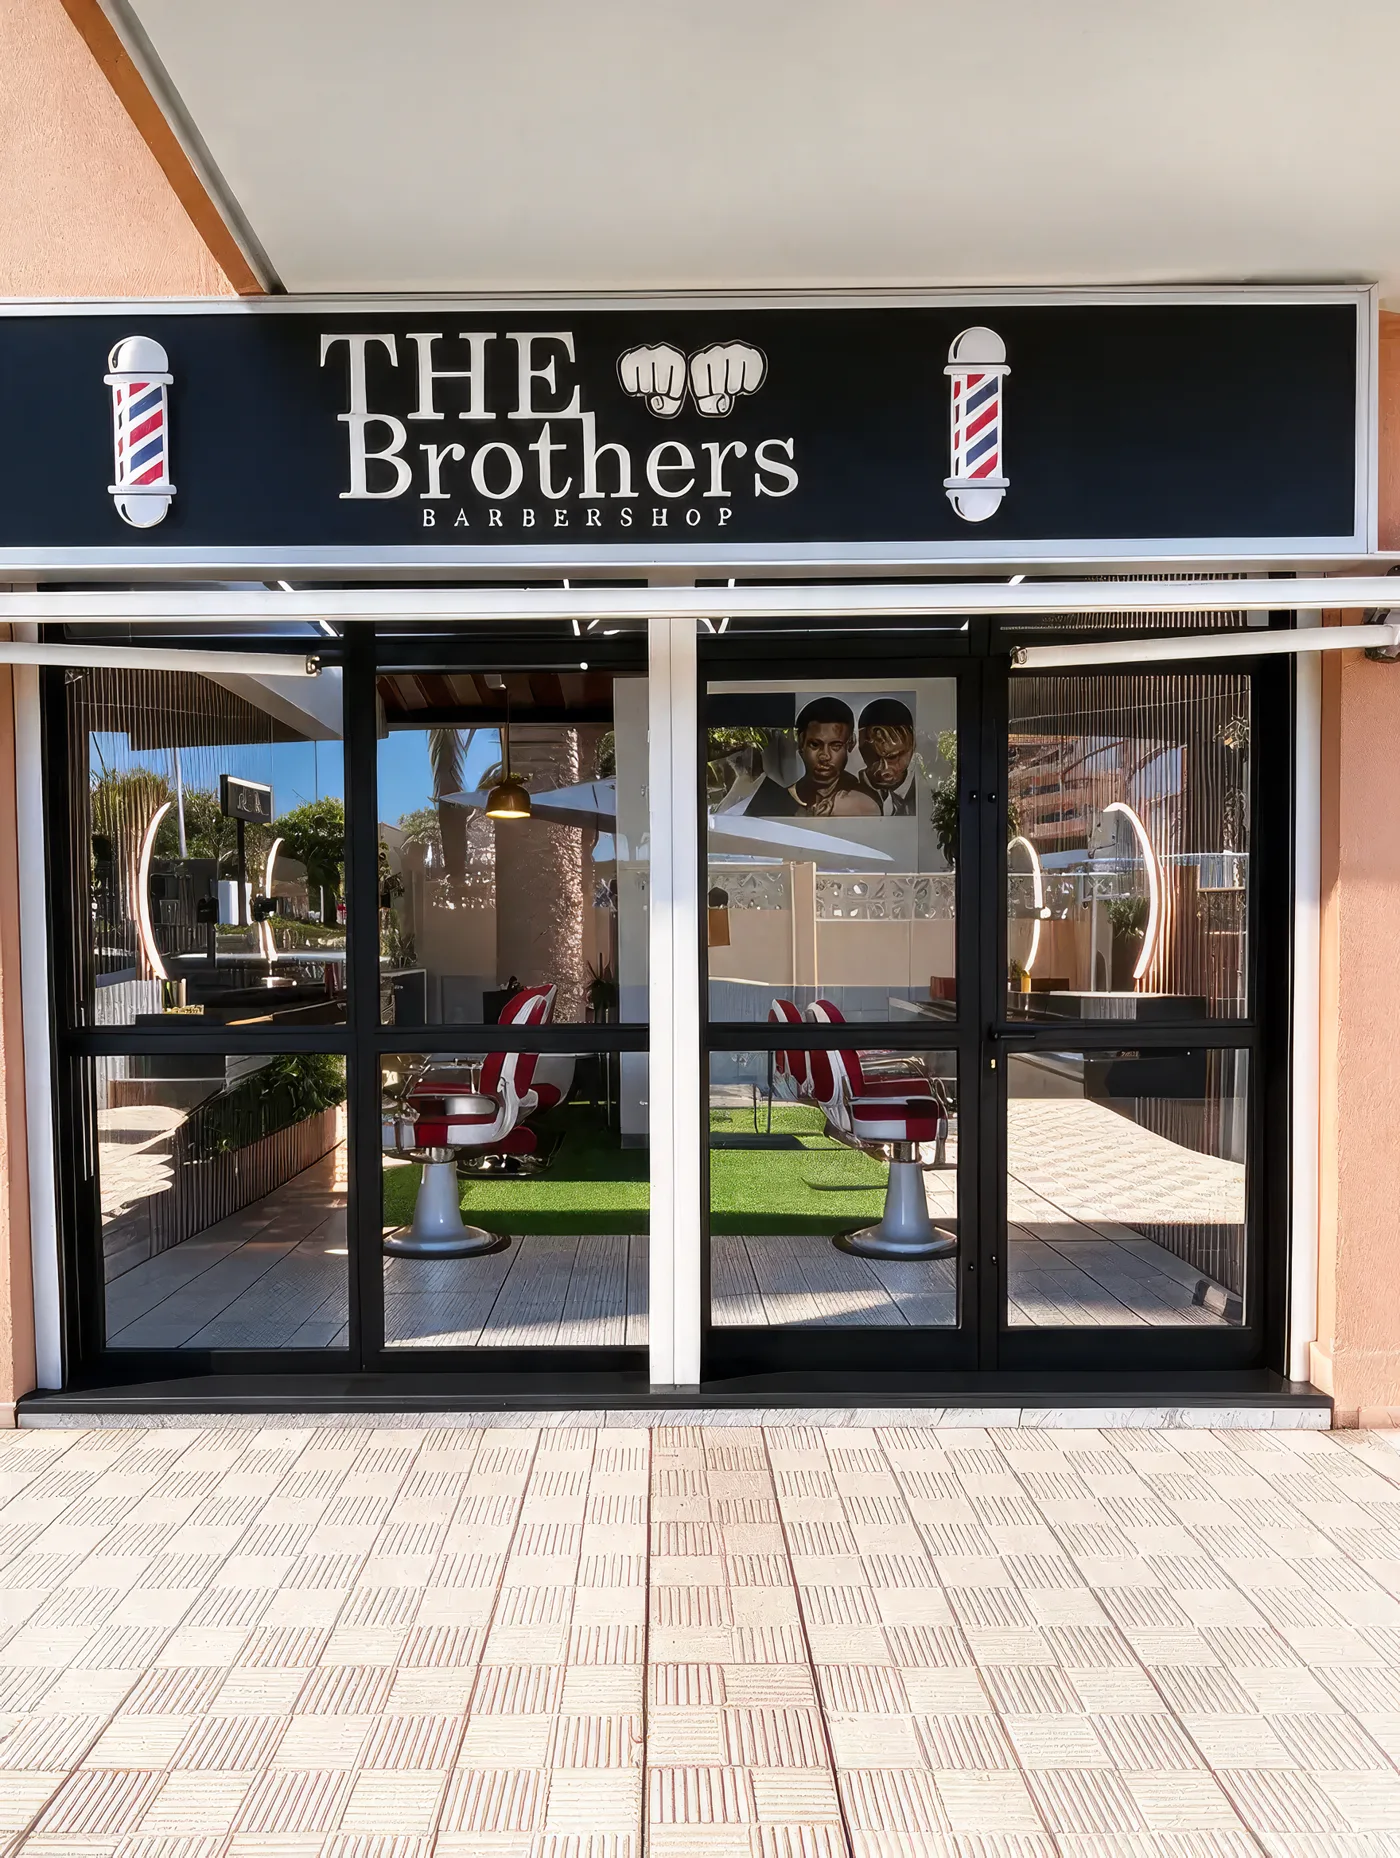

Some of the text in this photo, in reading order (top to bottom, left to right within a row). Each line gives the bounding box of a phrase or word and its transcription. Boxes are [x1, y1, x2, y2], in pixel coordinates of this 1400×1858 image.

[320, 332, 582, 420] THE
[337, 411, 799, 500] Brothers
[422, 508, 733, 527] BARBERSHOP
